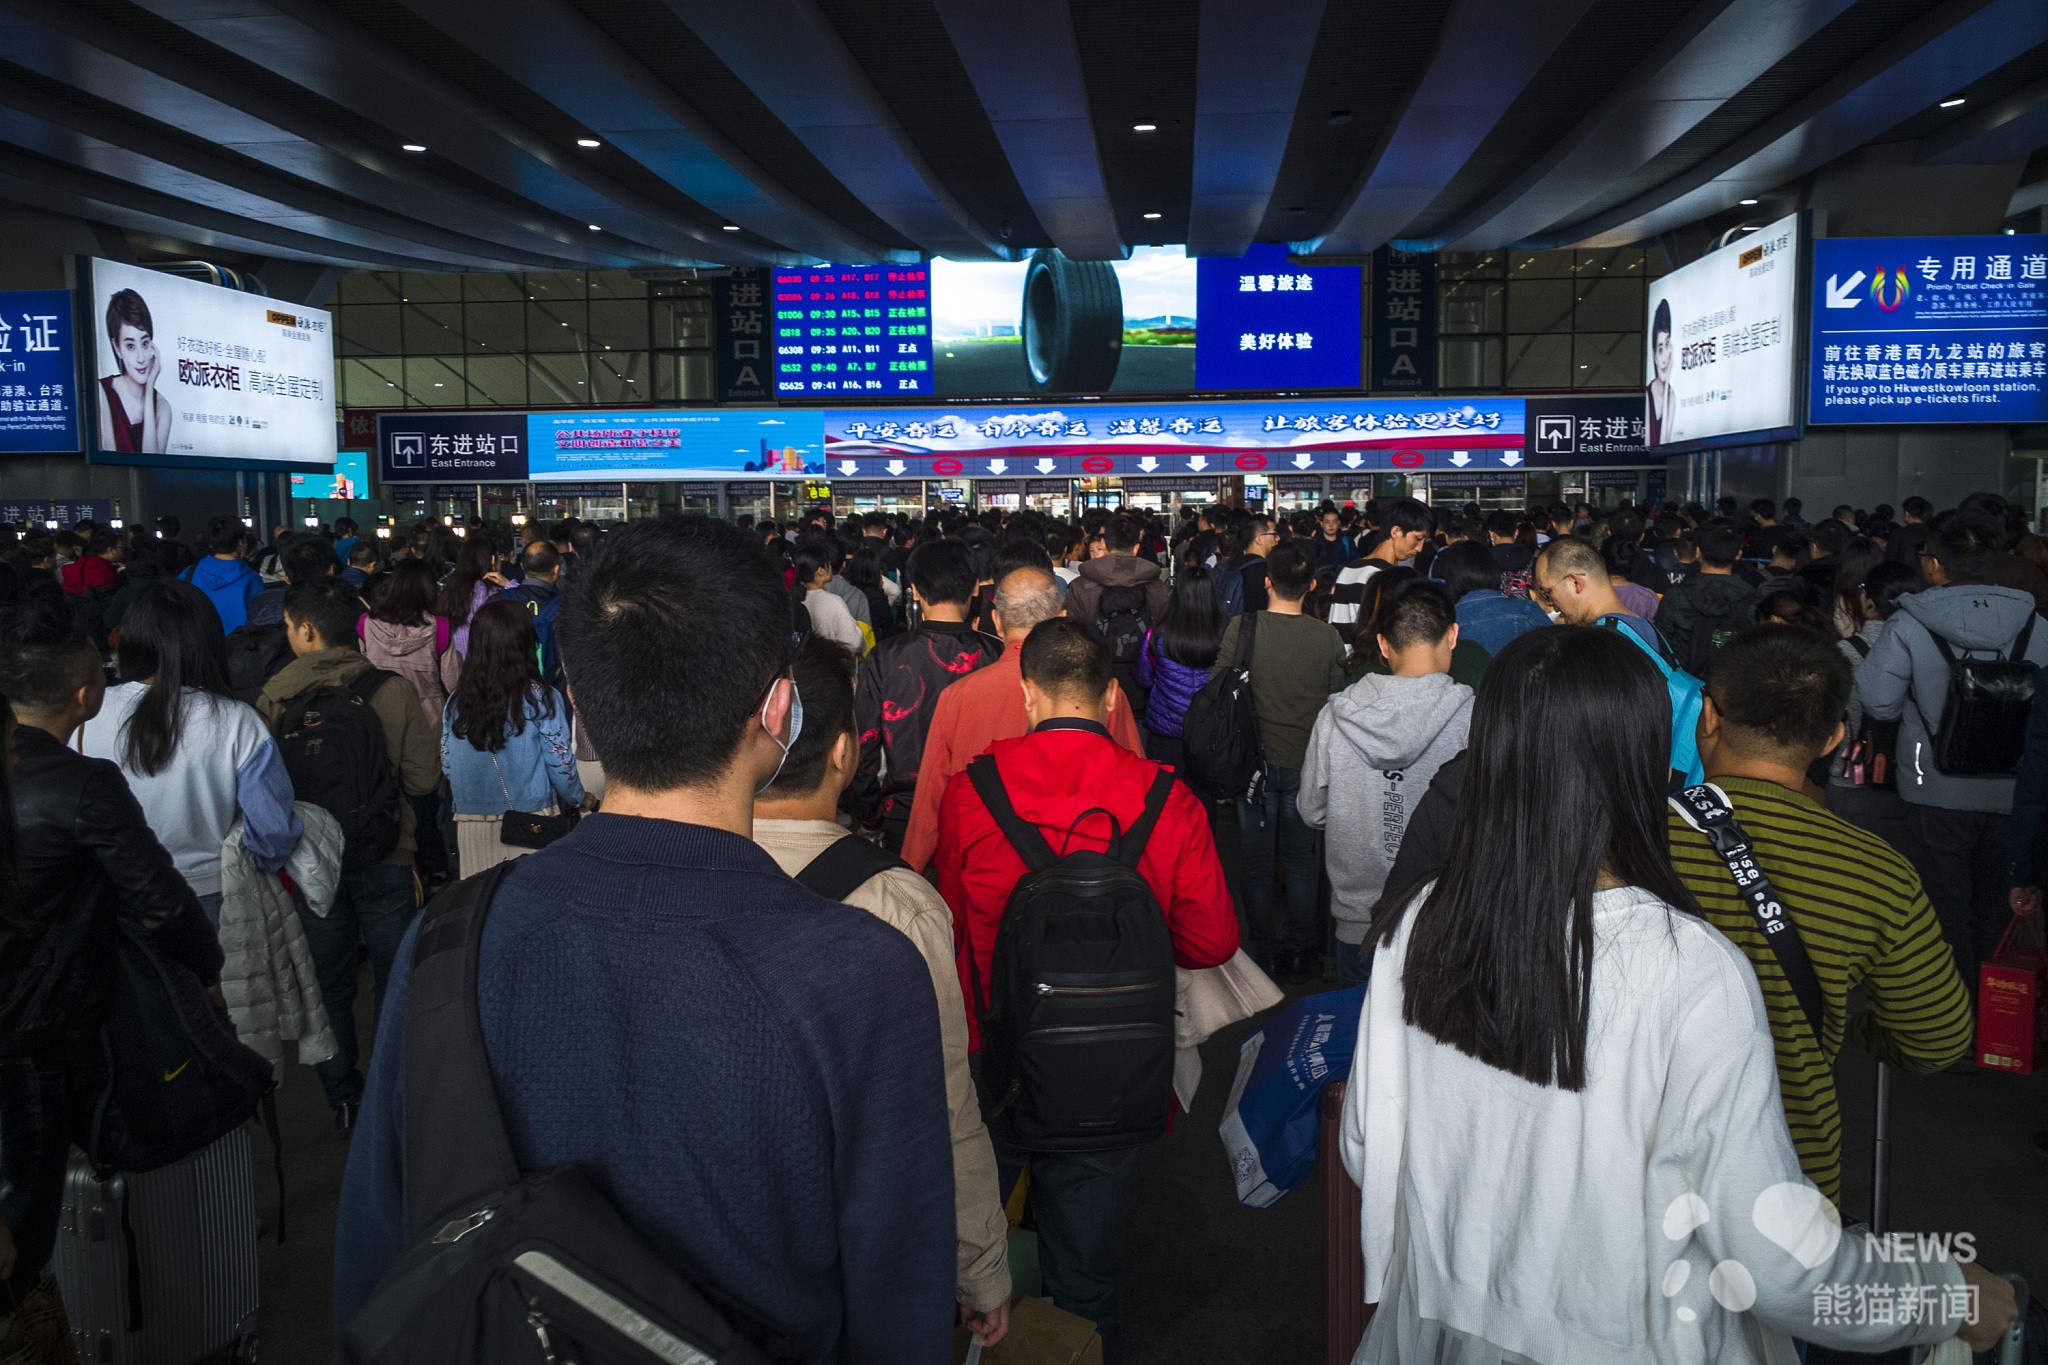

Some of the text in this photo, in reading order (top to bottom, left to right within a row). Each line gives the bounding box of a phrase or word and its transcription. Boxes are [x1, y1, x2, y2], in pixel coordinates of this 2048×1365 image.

[1916, 253, 2048, 281] 专用通道
[809, 274, 835, 283] 09:25
[1239, 273, 1313, 292] 温馨旅途
[810, 309, 836, 319] 09:30
[888, 307, 926, 318] 正在检票
[810, 327, 837, 337] 09:35
[888, 325, 927, 336] 正在检票
[811, 345, 837, 354] 09:38
[898, 343, 918, 353] 正点
[1239, 332, 1313, 351] 美好体验
[1824, 342, 2047, 361] 前往香港西九龙站的旅客
[780, 363, 801, 372] G532
[811, 362, 837, 372] 09:40
[889, 360, 927, 371] 正在检票
[1822, 361, 2047, 380] 请先换取蓝色磁介质车票再进站乘车
[178, 358, 323, 401] 欧派衣柜 高端全屋定制
[779, 381, 804, 390] G5625
[811, 380, 837, 390] 09:41
[899, 378, 918, 389] 正点
[1825, 384, 1835, 393] If
[1837, 385, 1859, 396] you
[1861, 385, 1877, 396] go
[1879, 384, 1892, 393] to
[1894, 383, 1991, 393] Hkwestkowloon
[1825, 395, 1867, 406] please
[1868, 394, 1894, 406] pick
[1897, 396, 1913, 406] up
[1914, 394, 1969, 404] e-tickets
[845, 412, 1502, 439] 平安春运 有序春运 温馨春运 让旅客体验更美好
[1579, 416, 1645, 440] 东进站
[429, 433, 518, 455] 东进站口
[1579, 443, 1604, 453] East
[431, 458, 496, 467] East Entrance
[3, 505, 94, 524] 进站通道
[1383, 768, 1404, 861] S-PERFEC
[1729, 861, 1751, 886] and
[1740, 855, 1760, 880] se
